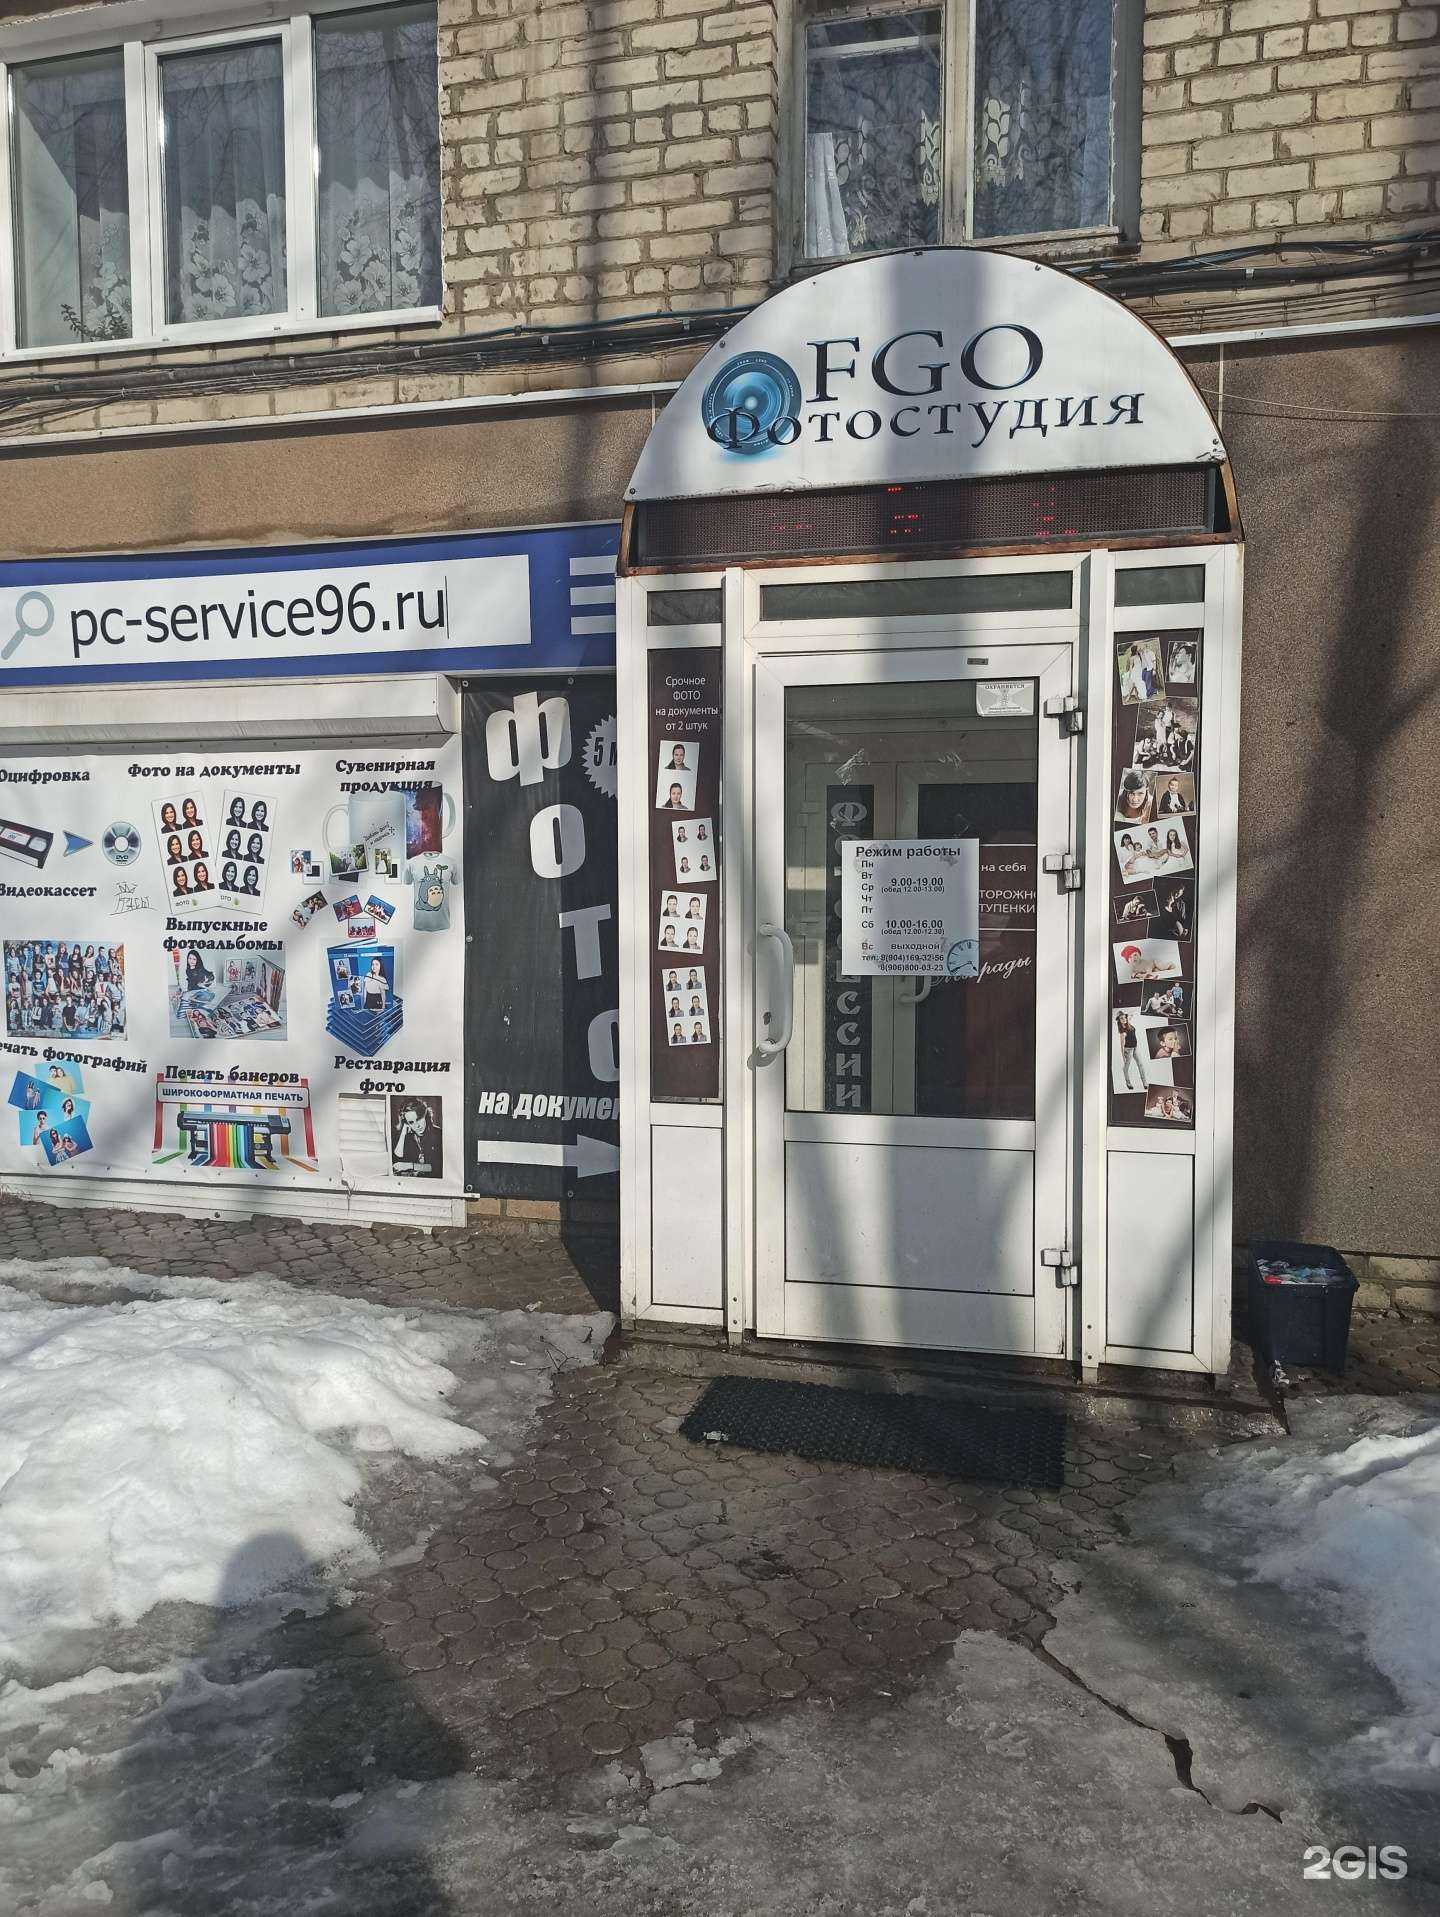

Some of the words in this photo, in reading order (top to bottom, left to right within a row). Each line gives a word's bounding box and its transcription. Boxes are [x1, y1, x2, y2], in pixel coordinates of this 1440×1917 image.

[806, 323, 1044, 403] FGO
[706, 392, 1146, 450] Фотостудия
[70, 582, 446, 657] pc-service96.ru
[665, 676, 706, 688] Срочное
[655, 708, 666, 716] на
[667, 707, 719, 718] документы
[665, 723, 675, 731] от
[677, 721, 684, 731] 2
[685, 722, 708, 733] штук
[593, 736, 604, 767] 5
[127, 763, 171, 778] Фото
[175, 766, 195, 777] на
[199, 763, 301, 779] документы
[335, 759, 436, 774] Сувенирная
[0, 769, 91, 785] Оцифровка
[340, 780, 434, 795] продукция
[855, 846, 902, 858] Режим
[906, 845, 961, 860] работы
[861, 860, 874, 868] Пн
[981, 864, 996, 872] на
[998, 862, 1028, 872] себя
[861, 871, 873, 880] Вт
[890, 877, 944, 887] 9.00-19.00
[861, 883, 874, 892] Ср
[979, 889, 1036, 900] ТОРОЖН
[861, 906, 873, 914] Пт
[979, 903, 1036, 914] ТУПЕНКИ
[165, 917, 268, 934] Выпускные
[861, 920, 874, 929] Сб
[886, 919, 944, 929] 10.00-16.00
[162, 934, 283, 952] фотоальбомы
[861, 942, 874, 950] Вс
[890, 942, 940, 951] выходной
[42, 1046, 148, 1074] фотографий
[334, 1055, 451, 1074] Реставрация
[165, 1065, 225, 1082] Печать
[229, 1065, 300, 1086] банеров
[359, 1078, 406, 1095] фото
[162, 1088, 263, 1101] ШИРОКОФОРМАТНАЯ
[263, 1091, 304, 1102] ПЕЧАТЬ
[477, 1091, 511, 1116] на
